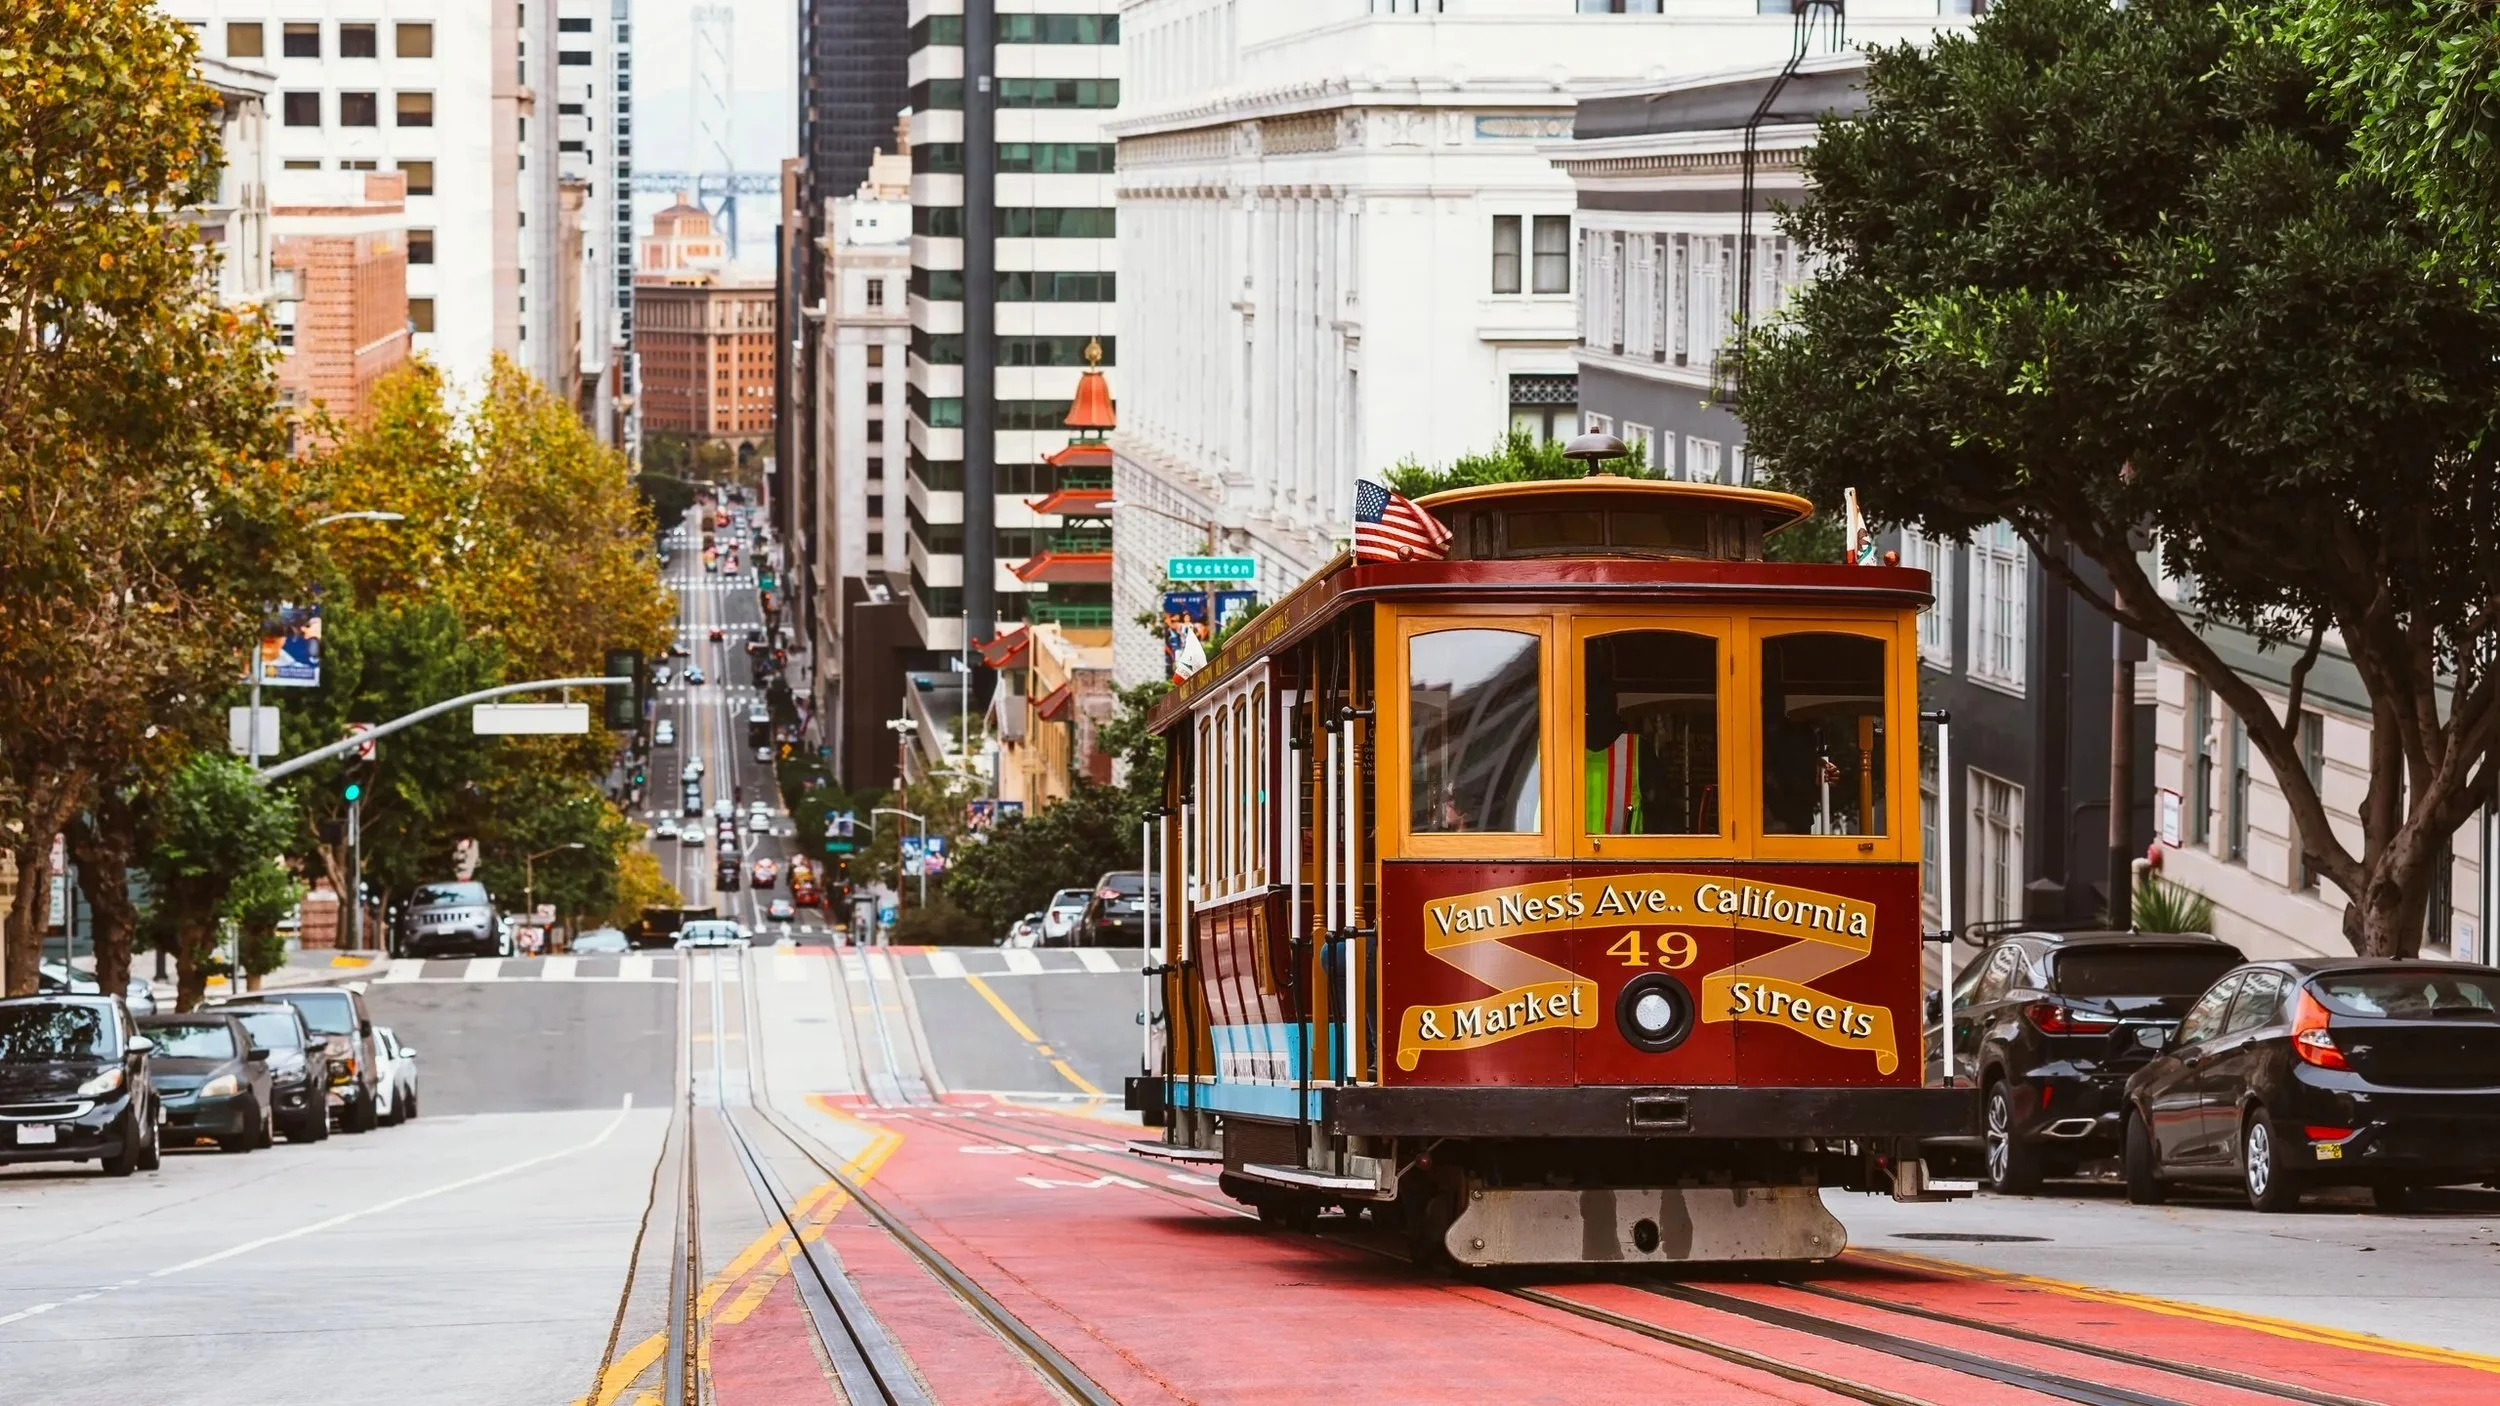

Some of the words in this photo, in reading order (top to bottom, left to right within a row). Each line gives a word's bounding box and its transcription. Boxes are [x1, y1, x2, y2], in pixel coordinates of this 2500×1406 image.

[1175, 562, 1249, 575] Stockton
[1431, 903, 1495, 937] Van
[1496, 891, 1586, 927] Ness
[1695, 883, 1868, 937] California
[1606, 930, 1698, 970] 49
[1419, 1009, 1448, 1042] &
[1450, 986, 1582, 1041] Market
[1729, 982, 1876, 1039] Streets
